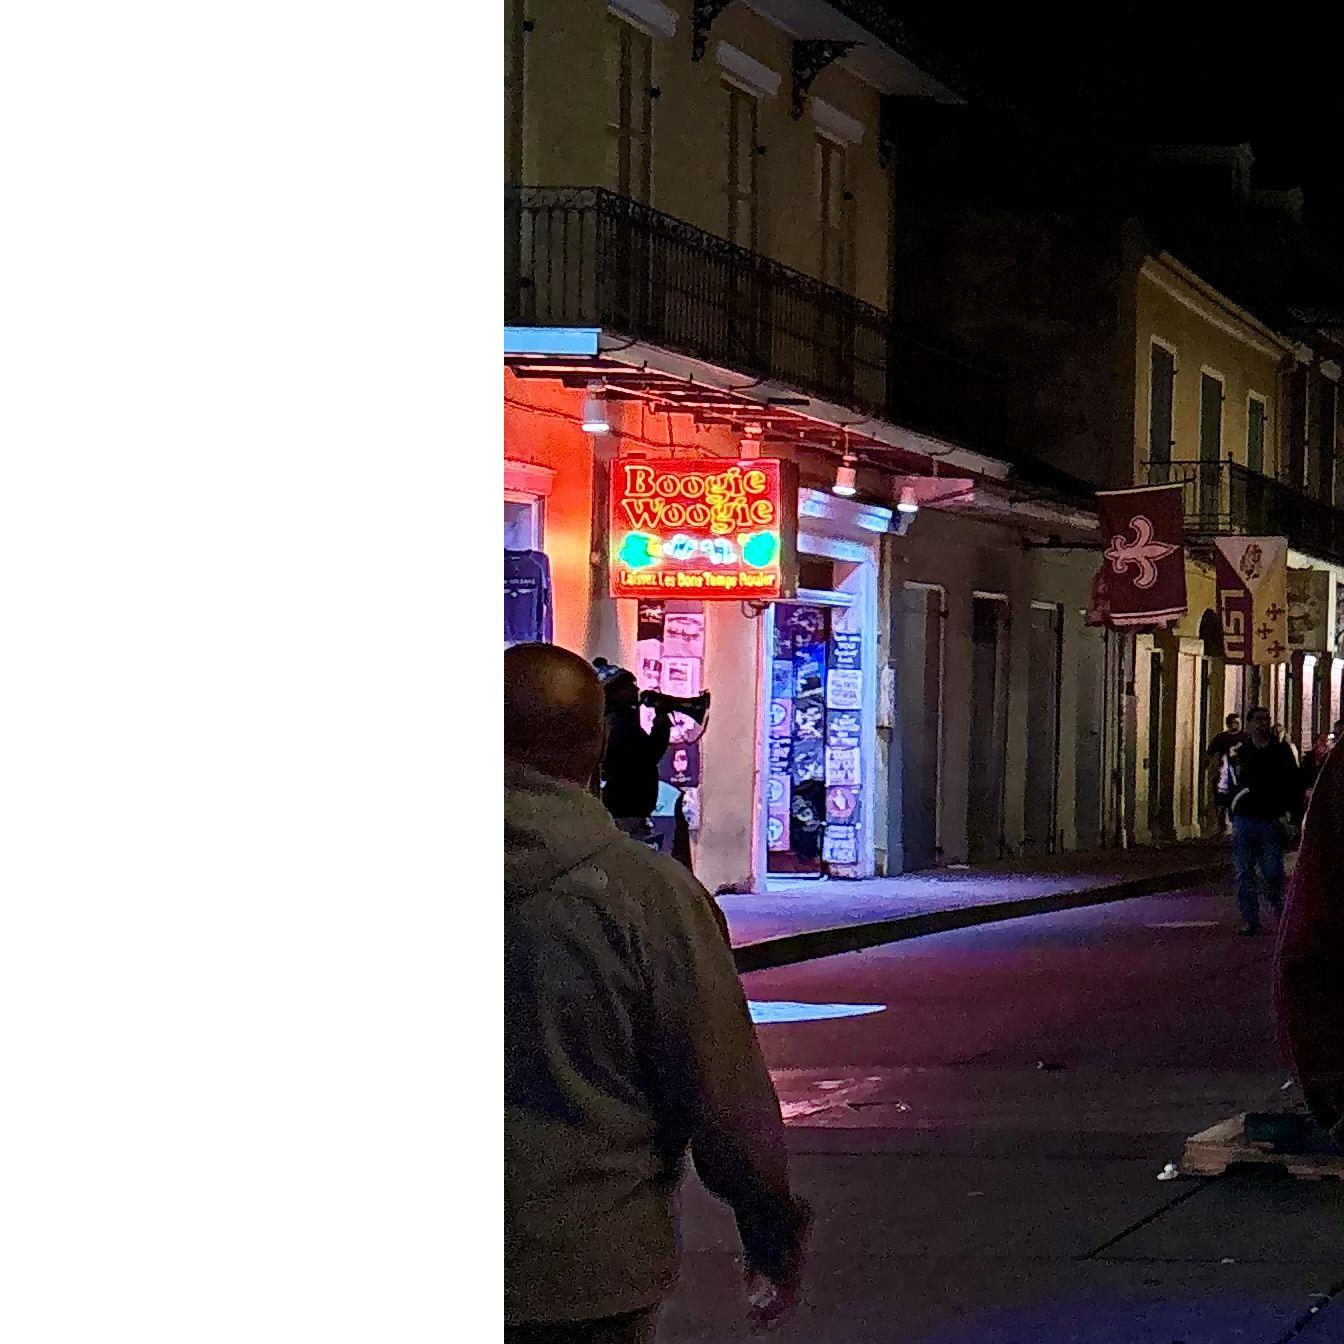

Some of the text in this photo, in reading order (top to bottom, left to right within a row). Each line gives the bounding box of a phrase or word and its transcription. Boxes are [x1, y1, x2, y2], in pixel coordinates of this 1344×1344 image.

[624, 464, 767, 505] Boogie
[621, 497, 774, 535] Woogie
[1220, 589, 1245, 659] LSU
